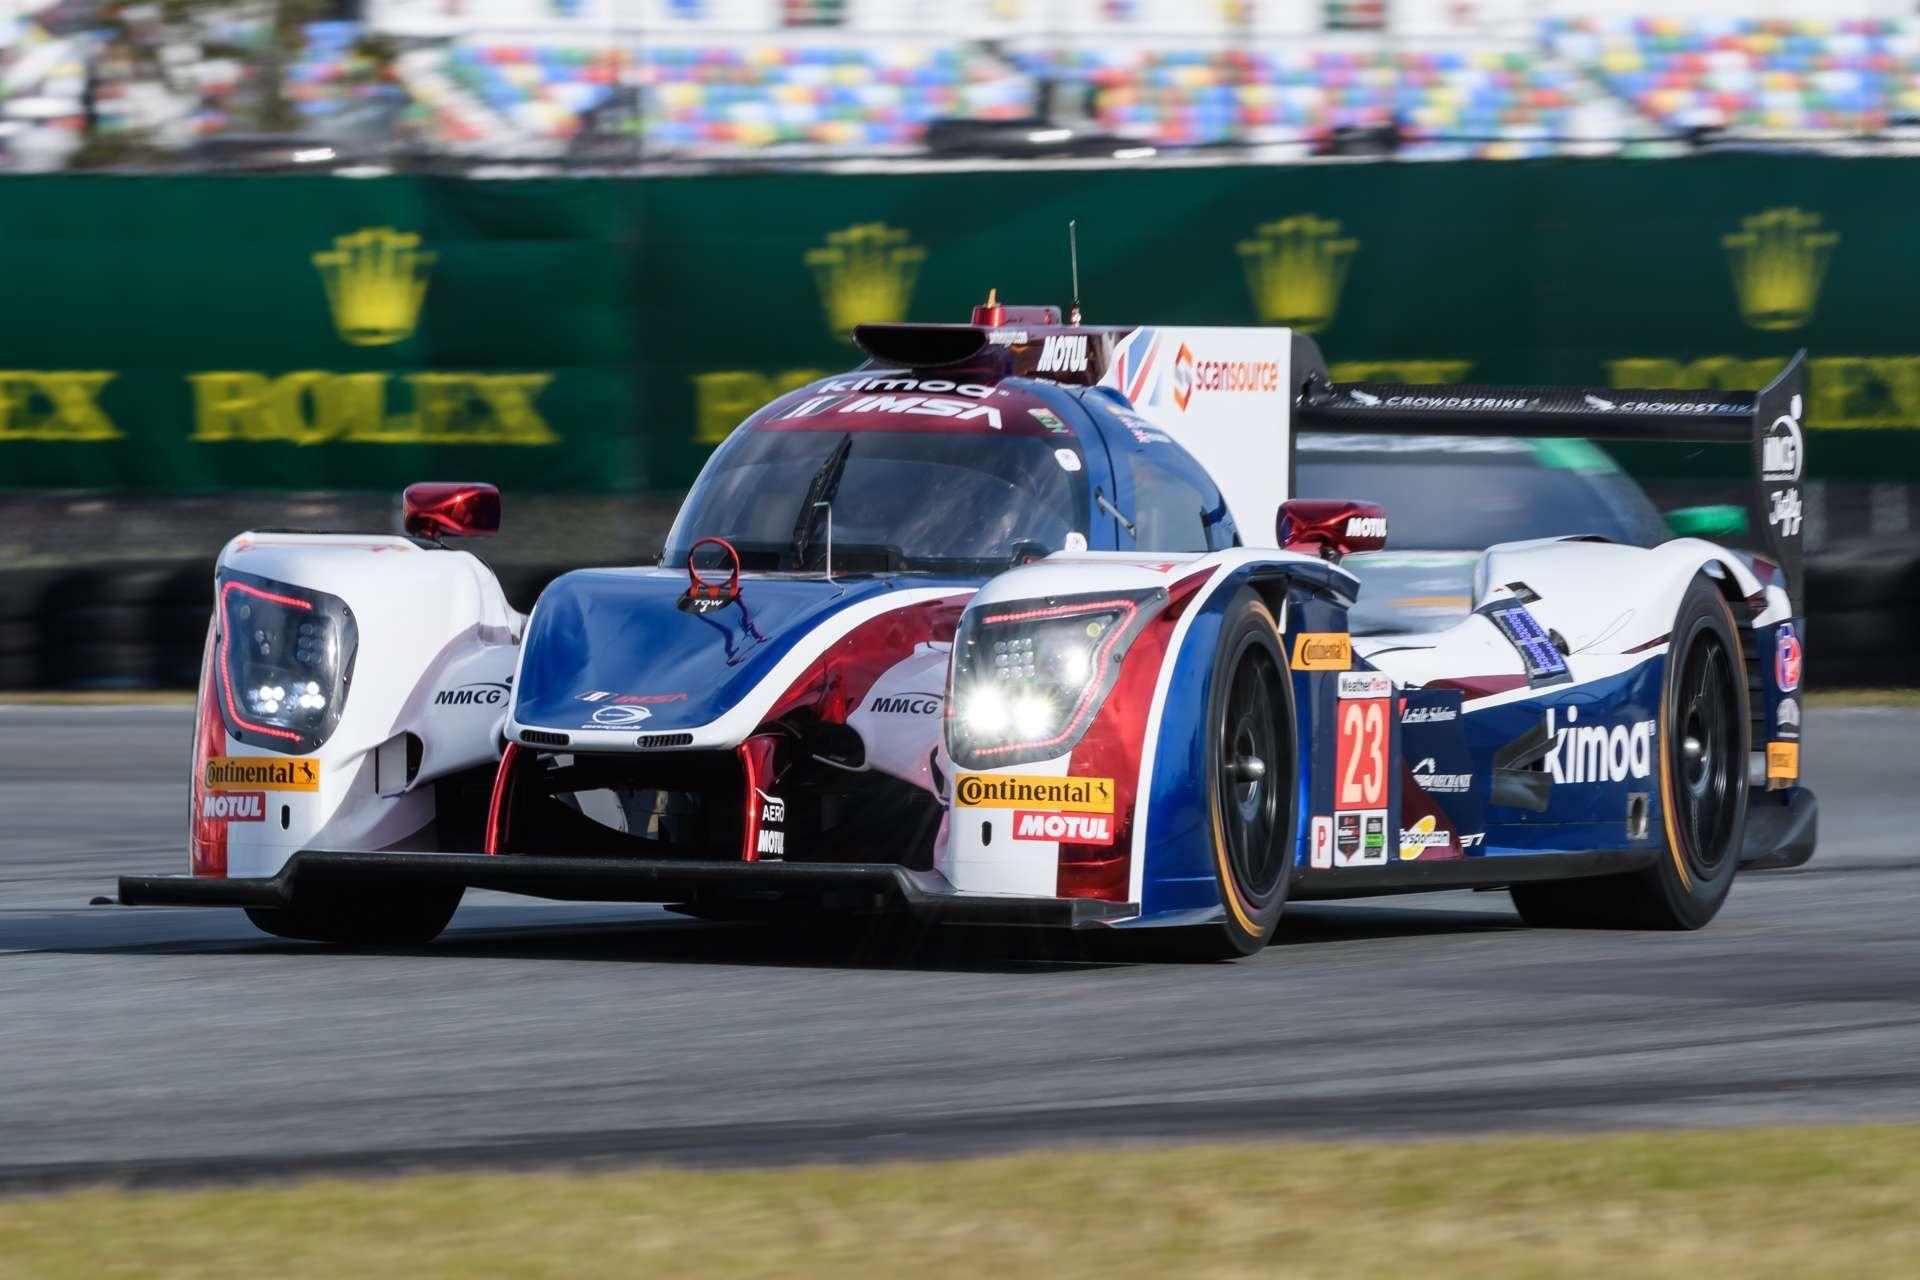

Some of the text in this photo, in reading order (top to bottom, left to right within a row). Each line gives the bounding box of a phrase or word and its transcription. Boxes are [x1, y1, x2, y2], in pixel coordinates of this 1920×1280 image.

[1036, 335, 1088, 373] MOTUL
[817, 376, 996, 399] kimoa
[1196, 360, 1278, 392] scansource
[187, 370, 557, 445] ROLEX
[837, 396, 1002, 430] IMSA
[1386, 396, 1528, 409] CROWDSTRIKE
[1345, 517, 1387, 537] MOTUL
[434, 690, 502, 705] MMCG
[870, 697, 939, 714] MMCG
[1341, 703, 1383, 803] 23
[1543, 705, 1650, 784] kimoa
[205, 760, 295, 789] Continental
[957, 776, 1091, 806] Continental
[203, 796, 262, 817] MOTUL
[762, 804, 785, 822] AERO
[1018, 815, 1110, 840] MOTUL
